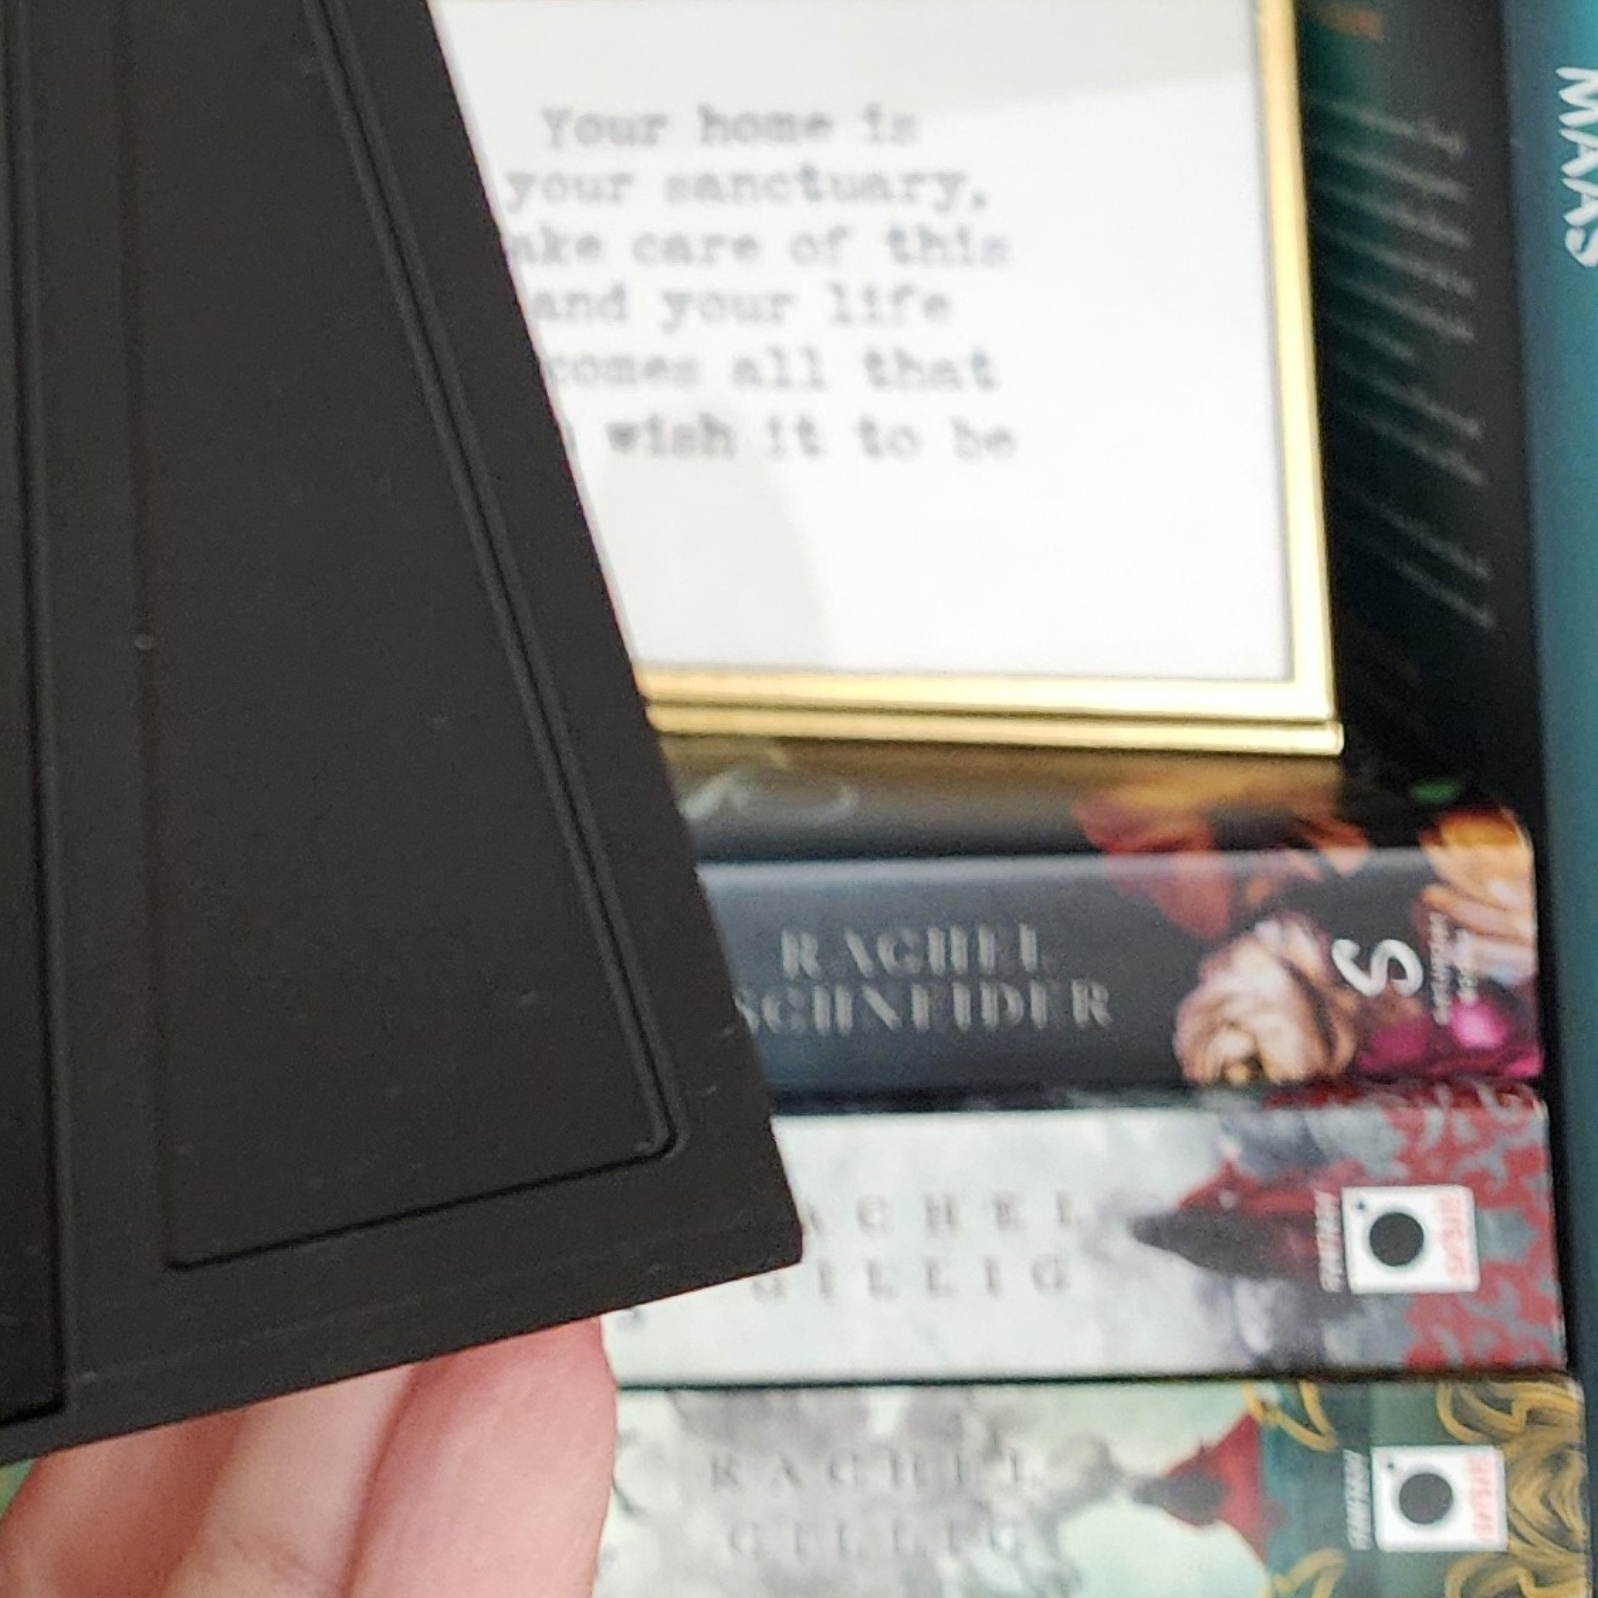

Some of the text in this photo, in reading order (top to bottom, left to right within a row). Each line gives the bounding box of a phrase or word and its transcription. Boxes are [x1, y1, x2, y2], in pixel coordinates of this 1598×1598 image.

[541, 101, 920, 149] Your home is
[506, 170, 636, 213] your
[632, 231, 761, 267] care
[790, 224, 853, 266] of
[886, 224, 1012, 267] this
[531, 280, 953, 334] and your life
[732, 345, 828, 389] all
[863, 346, 996, 391] that
[605, 412, 1018, 461] wish it to be
[781, 922, 1050, 981] RACHEL
